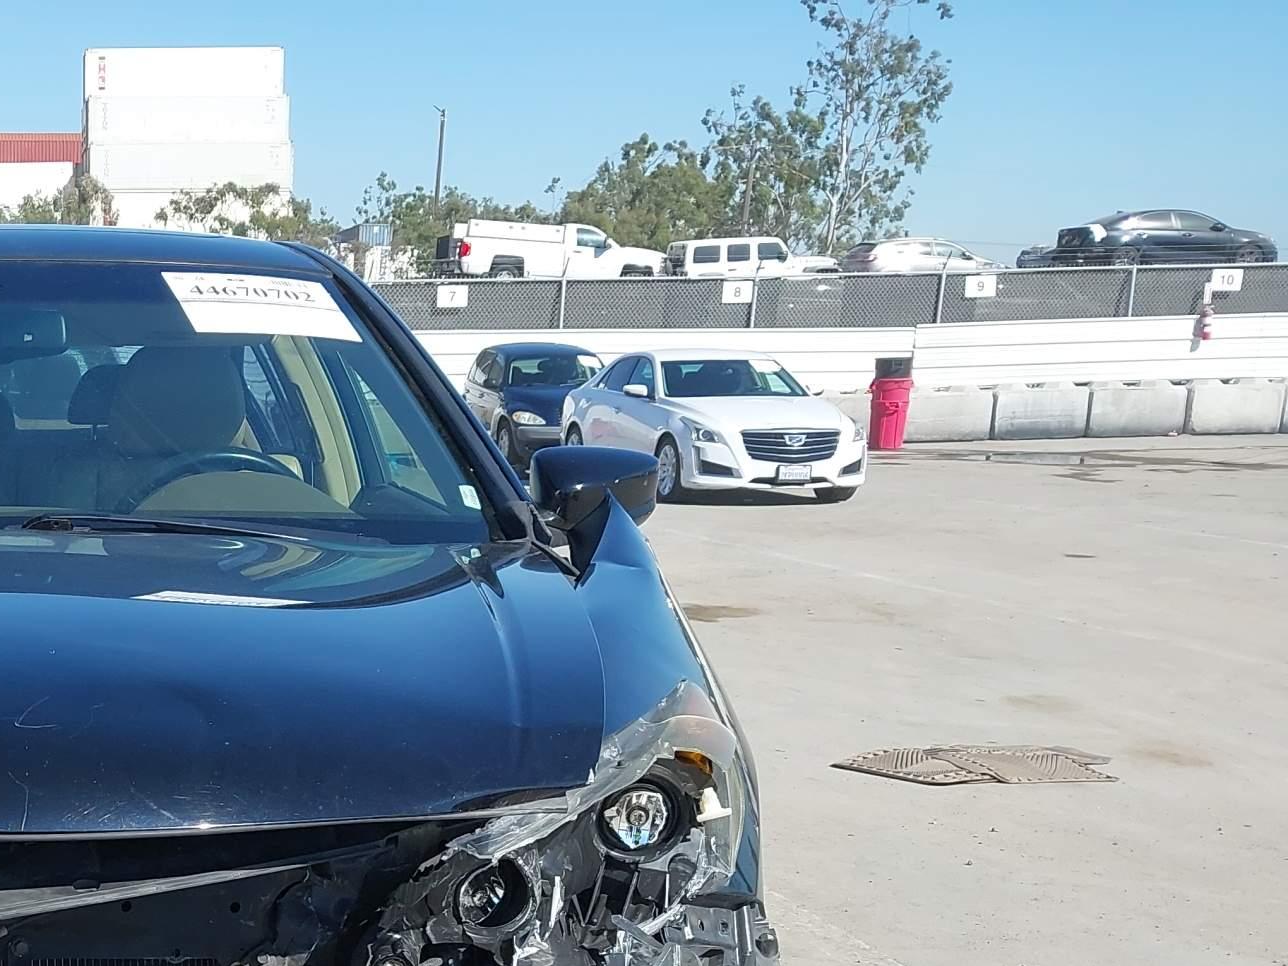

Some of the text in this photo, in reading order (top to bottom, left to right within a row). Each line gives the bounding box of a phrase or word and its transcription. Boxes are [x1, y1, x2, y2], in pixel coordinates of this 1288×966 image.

[1221, 274, 1234, 285] 10
[734, 286, 741, 297] 8
[977, 281, 985, 291] 9
[189, 284, 315, 302] 44670702
[448, 291, 456, 302] 7
